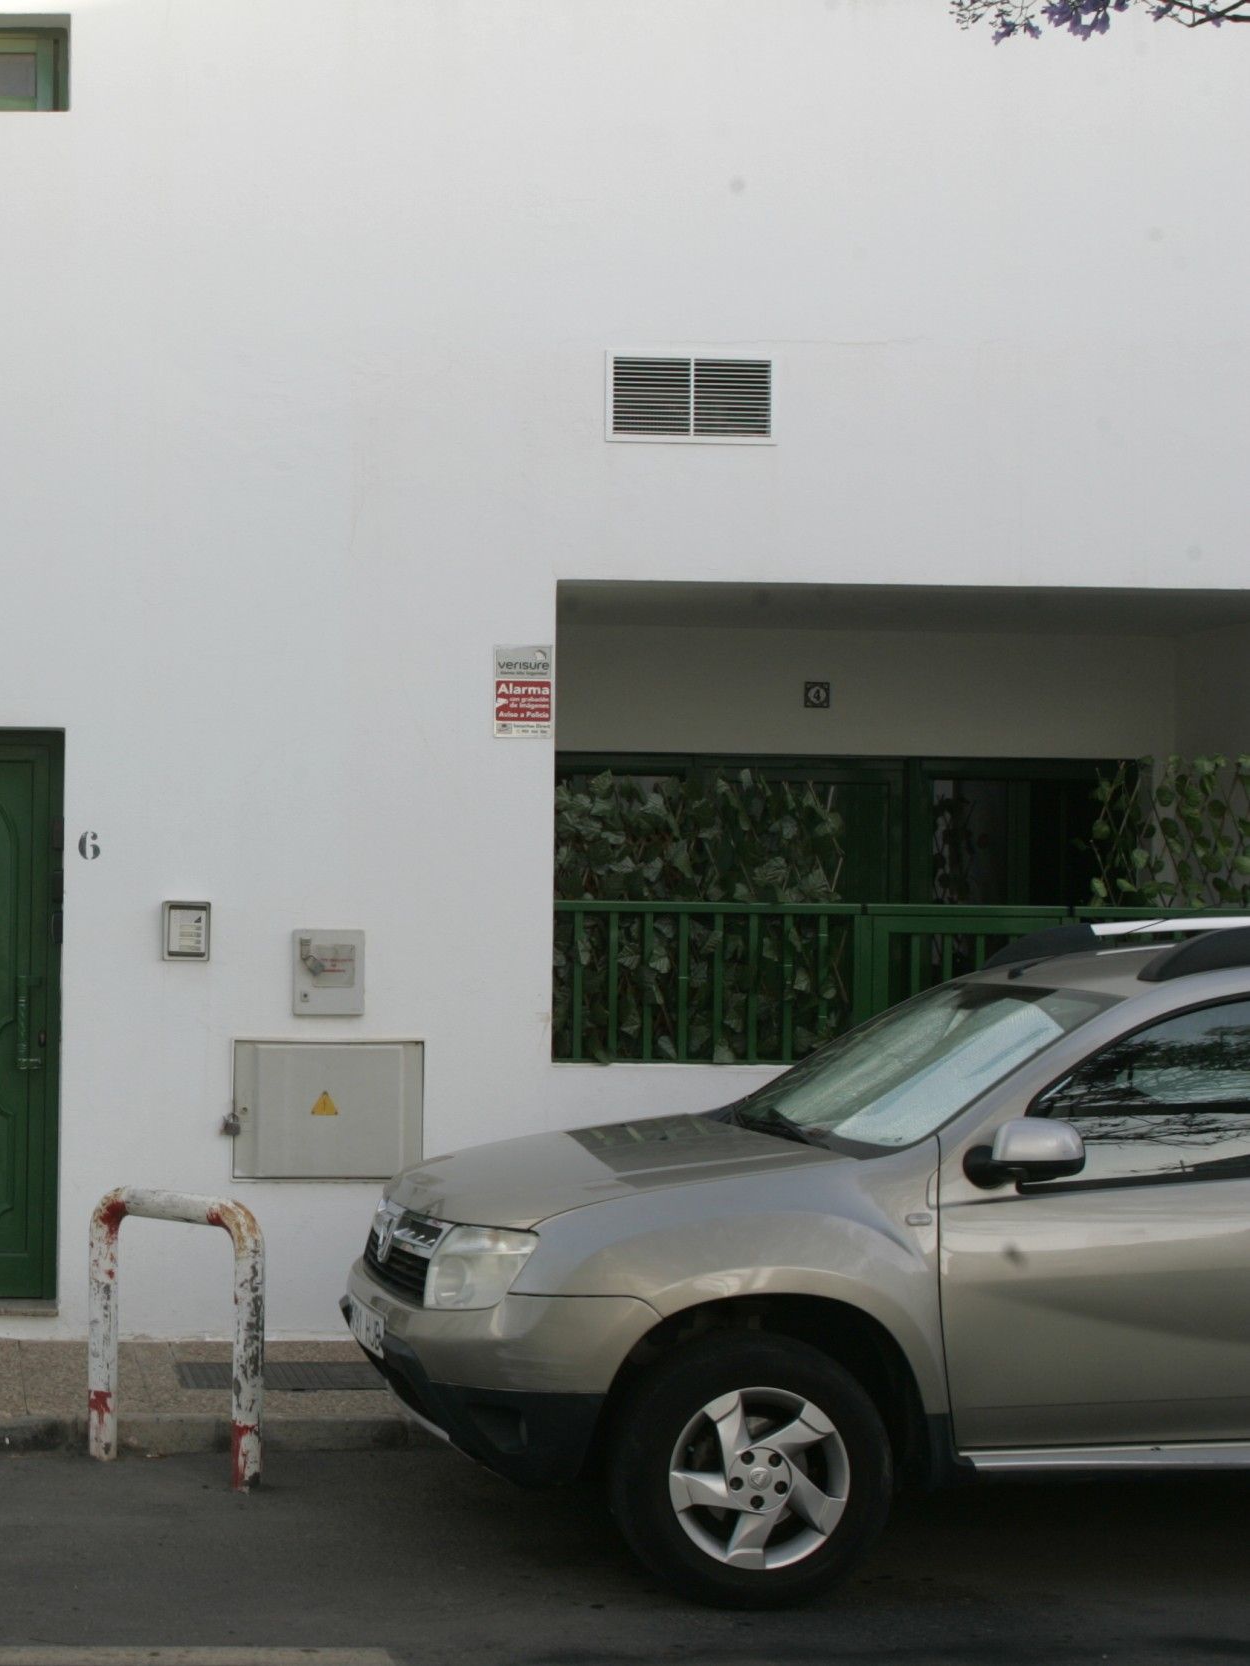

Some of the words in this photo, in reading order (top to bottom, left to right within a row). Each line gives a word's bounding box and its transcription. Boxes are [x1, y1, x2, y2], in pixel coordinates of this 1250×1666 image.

[498, 661, 550, 671] verisure
[497, 683, 550, 695] Alarma
[814, 689, 821, 701] 4
[78, 831, 101, 860] 6
